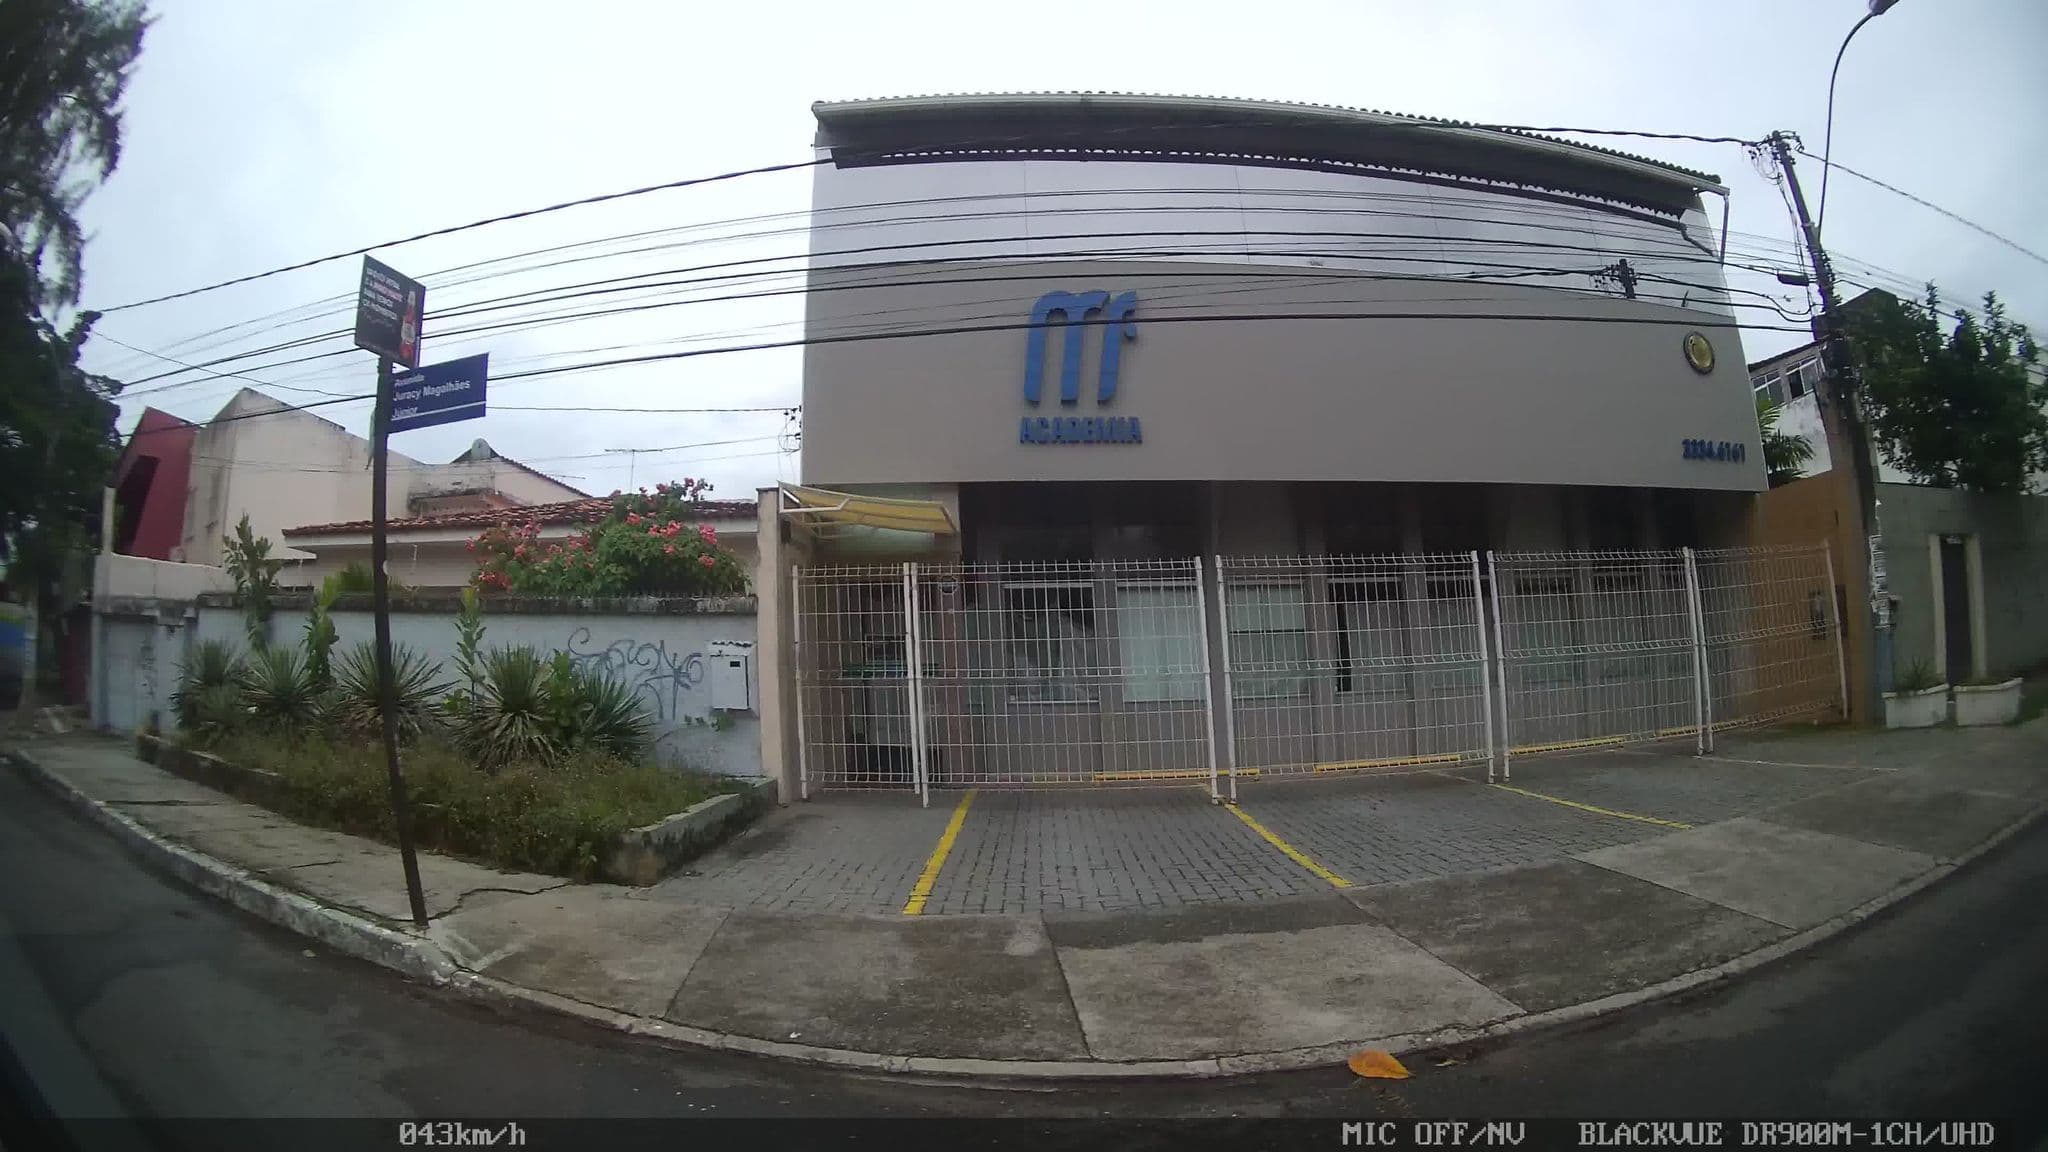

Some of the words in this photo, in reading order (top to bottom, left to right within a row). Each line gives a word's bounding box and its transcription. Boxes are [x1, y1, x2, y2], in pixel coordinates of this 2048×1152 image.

[393, 389, 422, 402] Juracy
[423, 379, 471, 397] Magalhães
[1020, 416, 1144, 444] ACADEMIA
